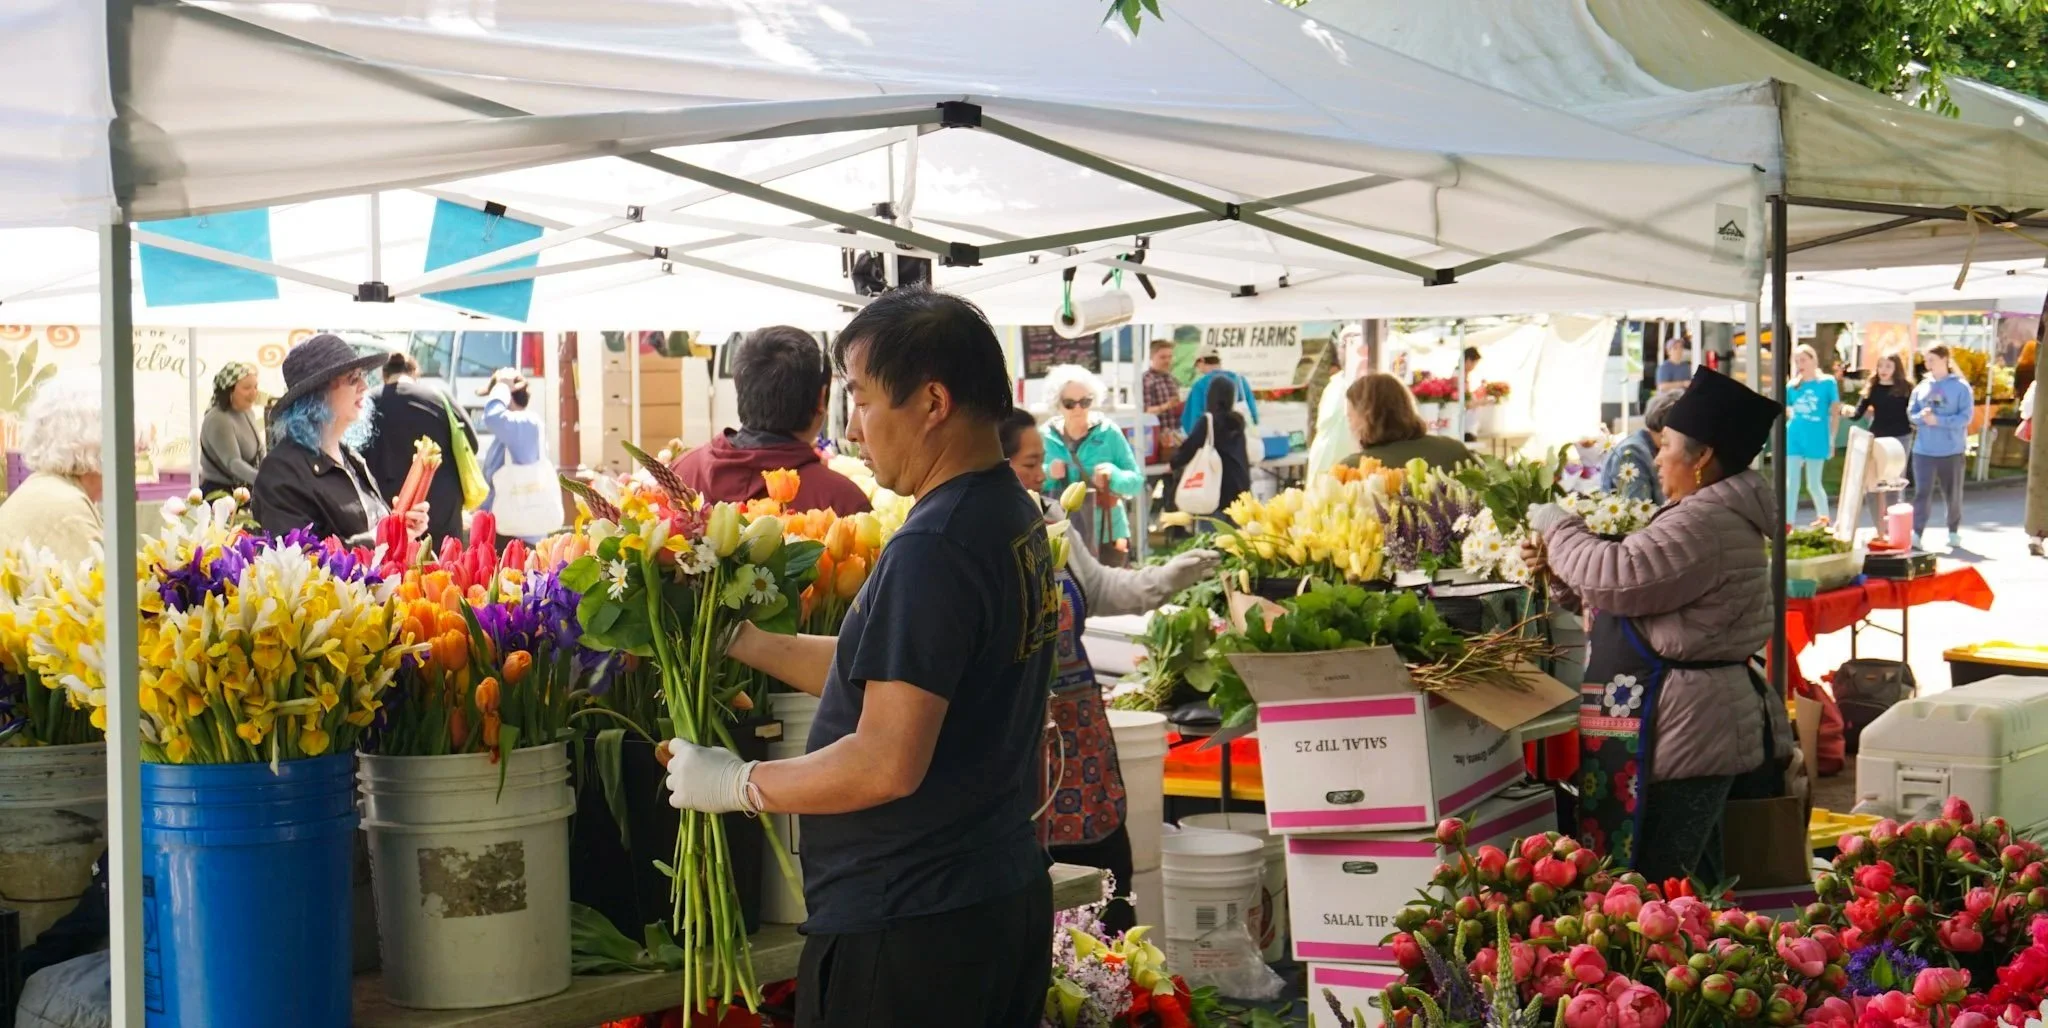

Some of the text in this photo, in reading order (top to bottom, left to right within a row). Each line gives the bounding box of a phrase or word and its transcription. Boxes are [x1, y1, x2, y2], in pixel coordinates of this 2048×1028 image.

[1206, 326, 1297, 348] OLSEN FARMS
[1295, 736, 1388, 753] SALAL TIP 25
[1323, 913, 1364, 926] SALAL
[1366, 915, 1389, 927] TIP
